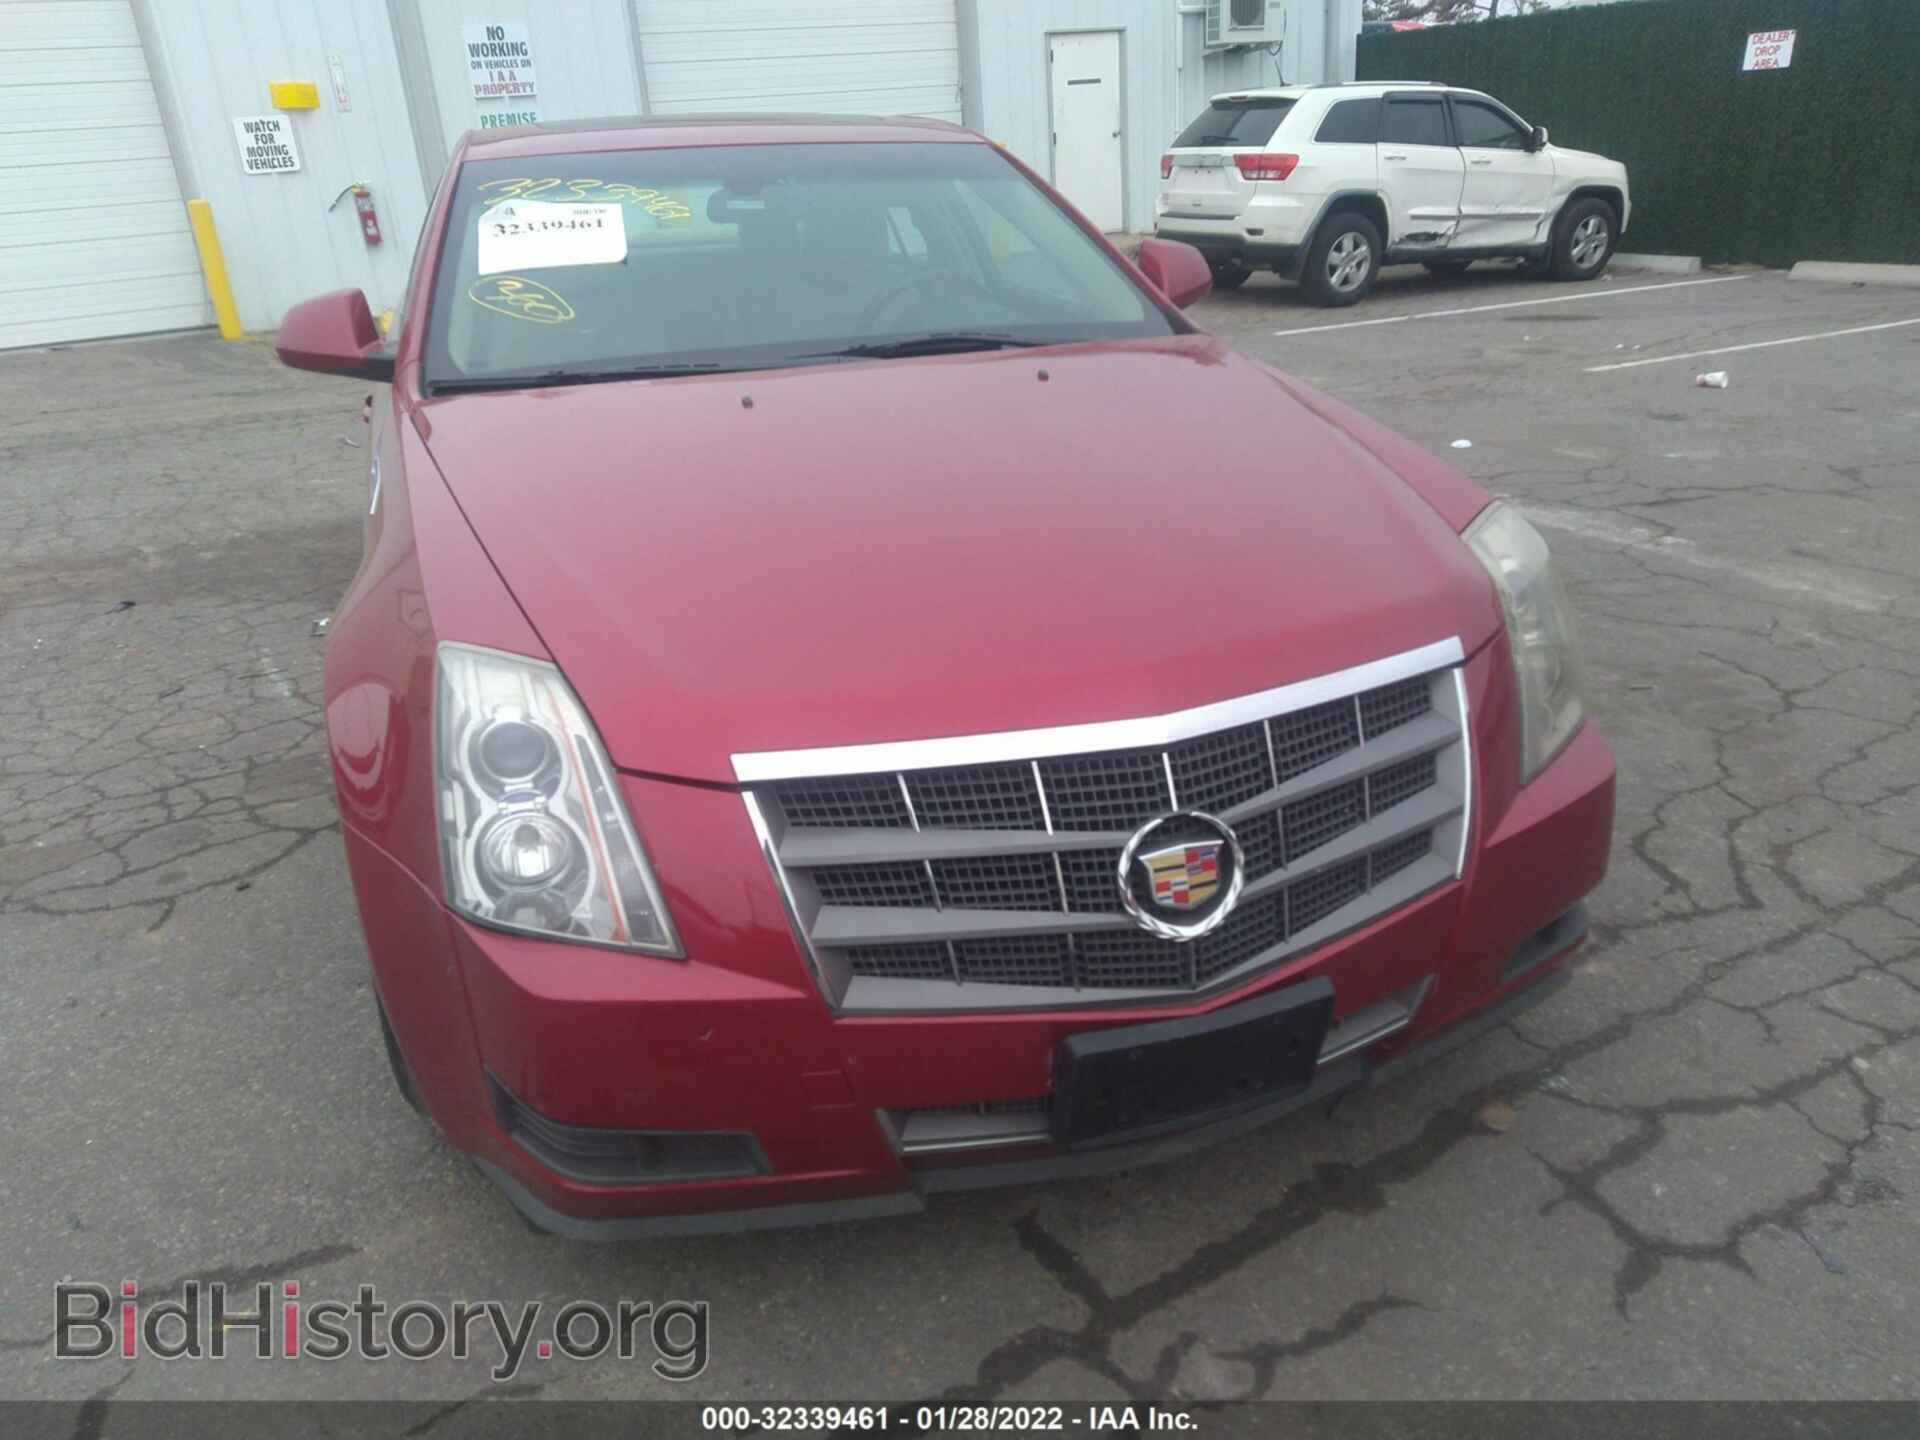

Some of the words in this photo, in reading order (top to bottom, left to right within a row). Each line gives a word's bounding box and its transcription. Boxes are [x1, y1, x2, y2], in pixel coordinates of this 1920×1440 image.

[486, 25, 505, 41] NO
[1752, 31, 1790, 45] DEALER
[467, 41, 529, 58] WORKING
[1755, 44, 1781, 57] DROP
[470, 60, 482, 70] ON
[484, 59, 519, 69] VEHICLES
[520, 58, 532, 68] ON
[1752, 57, 1779, 69] AREA
[473, 81, 535, 95] PROPERTY
[243, 119, 281, 134] WATCH
[254, 133, 275, 145] FOR
[246, 144, 289, 158] MOVING
[246, 156, 295, 170] VEHICLES
